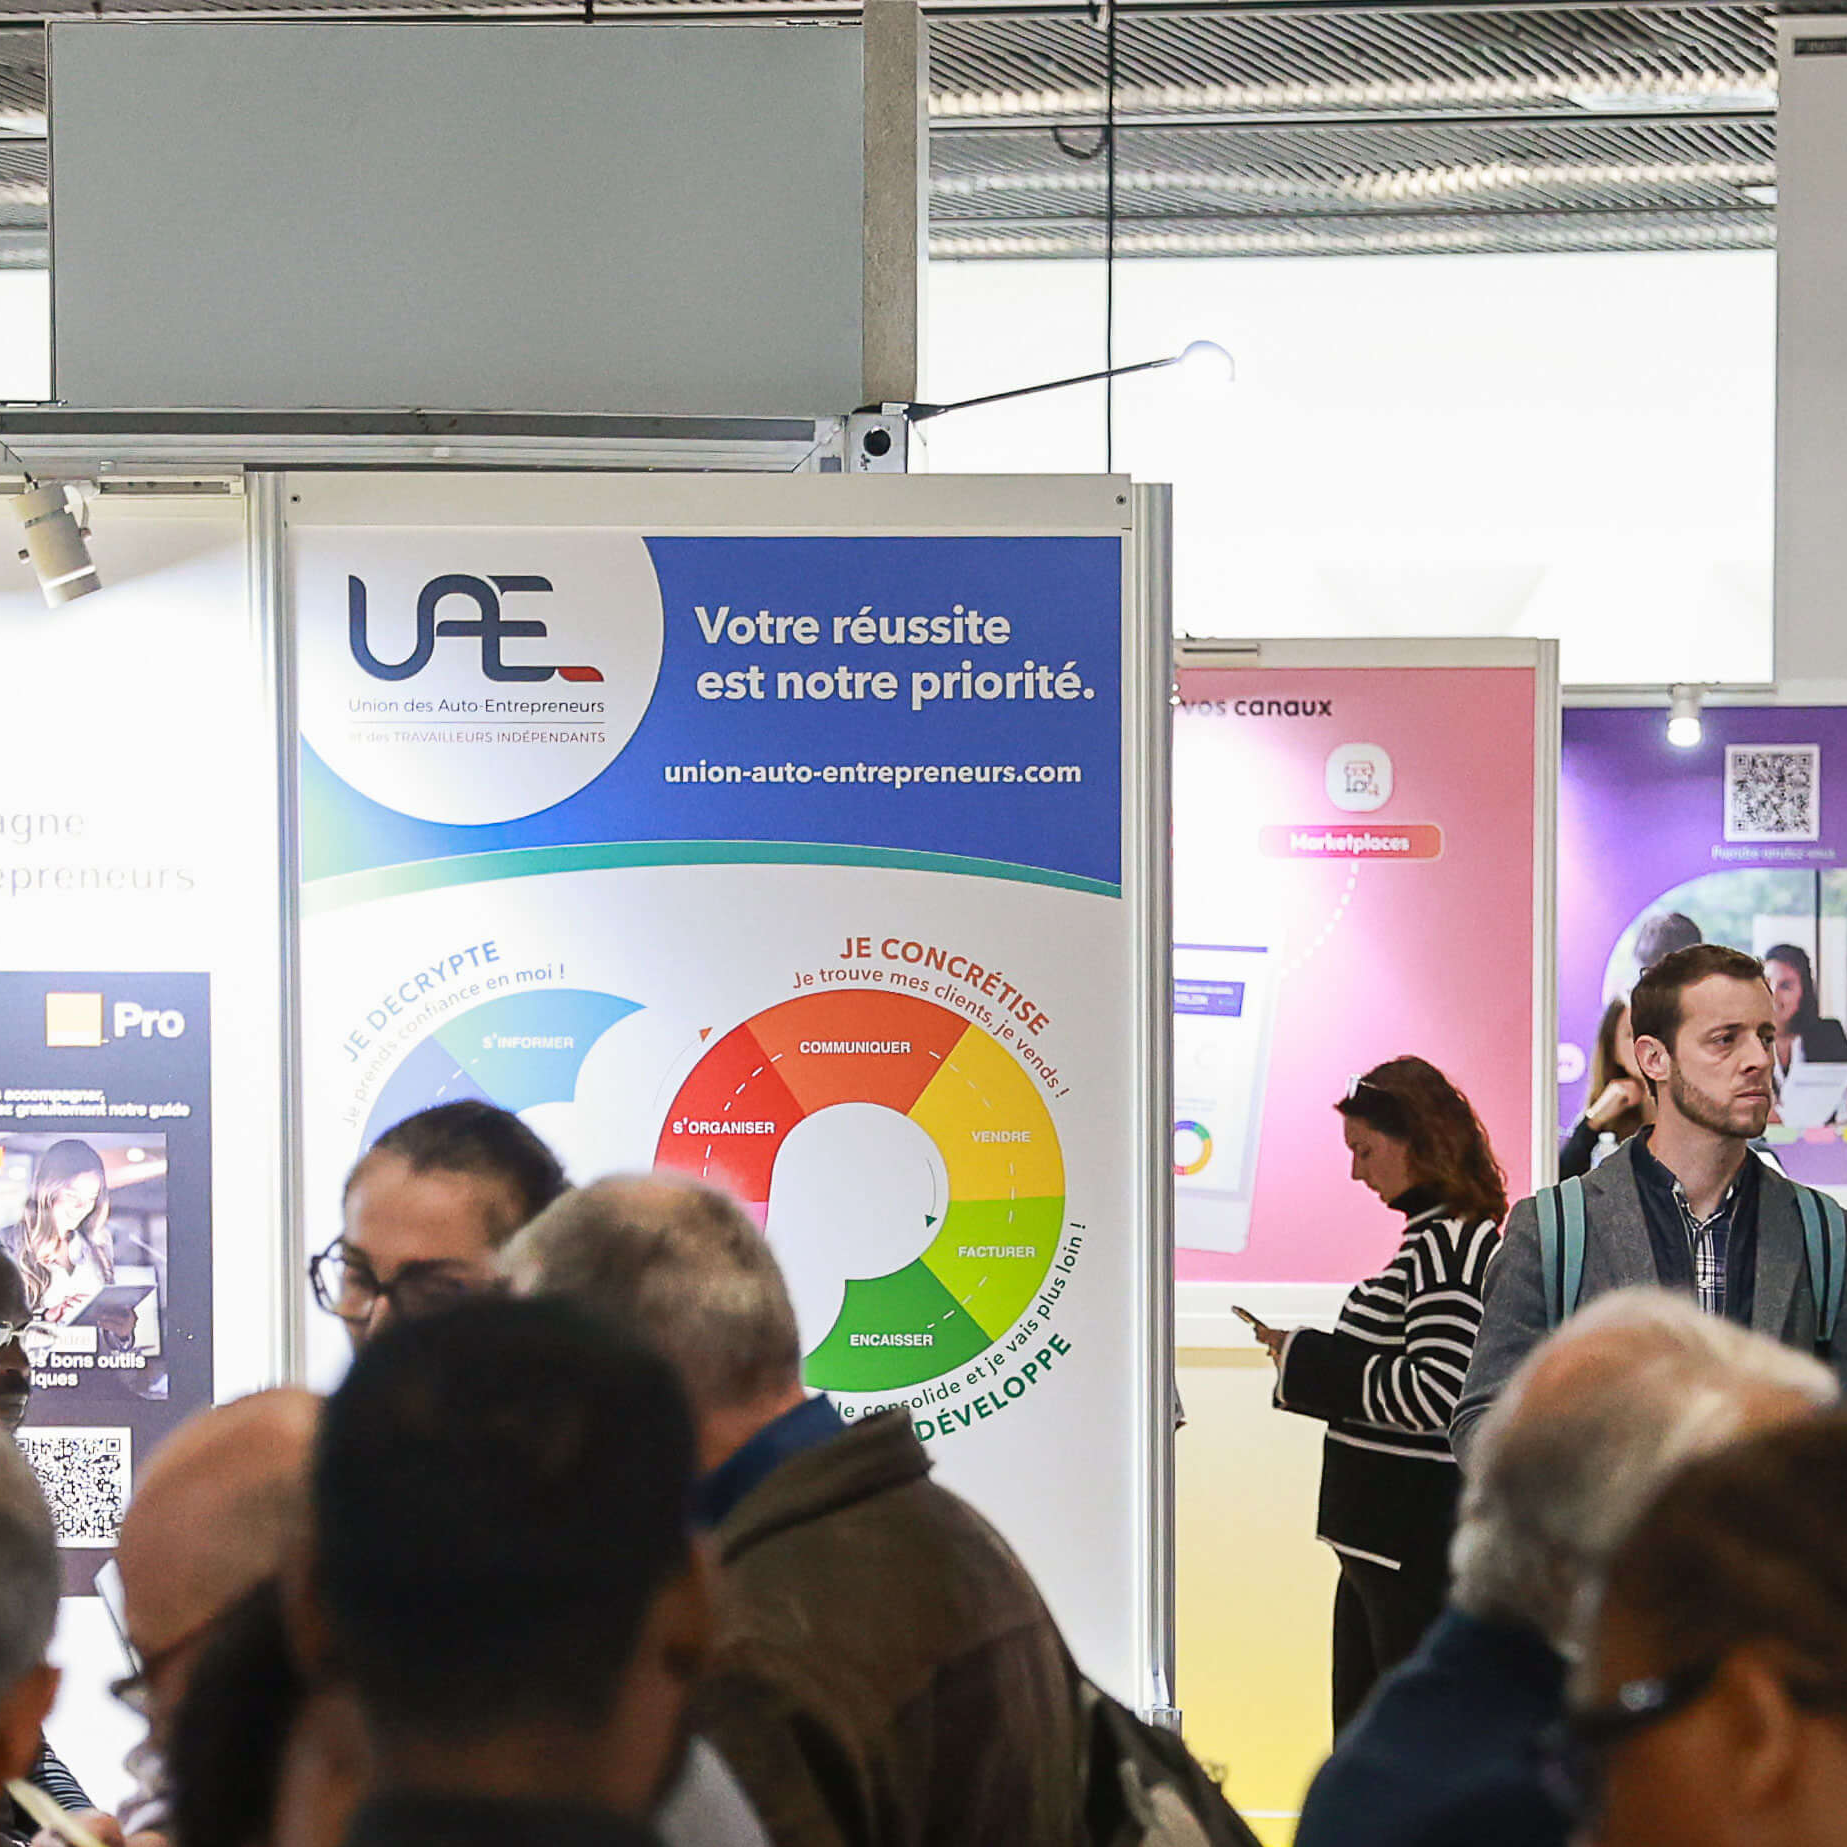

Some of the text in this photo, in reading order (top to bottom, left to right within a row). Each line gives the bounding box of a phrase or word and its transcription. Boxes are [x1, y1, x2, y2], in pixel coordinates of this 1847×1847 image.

[348, 574, 604, 682] UAE
[694, 604, 1011, 645] Votre réussite
[696, 660, 1095, 711] est notre priorité.
[348, 698, 605, 716] Union des Auto-Entrepreneurs
[1234, 698, 1333, 717] canaux
[394, 732, 493, 744] TRAVAILLEURS
[496, 729, 606, 744] INDÉPENDANTS
[664, 759, 1082, 789] union-auto-entrepreneurs.com
[1289, 832, 1410, 855] Marketplaces
[840, 937, 1050, 1036] JE CONCRÉTISE
[400, 982, 481, 1040] confiance
[485, 975, 510, 991] en
[515, 964, 553, 983] moi
[113, 1002, 186, 1040] Pro
[793, 971, 815, 990] Je
[819, 966, 884, 983] trouve
[890, 972, 930, 992] mes
[935, 982, 994, 1028] clients,
[993, 1019, 1014, 1041] je
[1017, 1038, 1060, 1090] vends
[341, 1029, 371, 1062] JE
[482, 1032, 575, 1050] S'INFORMER
[799, 1041, 911, 1055] COMMUNIQUER
[15, 1102, 107, 1119] gratuitement
[108, 1103, 147, 1117] notre
[149, 1102, 191, 1120] guide
[672, 1117, 775, 1134] S'ORGANISER
[971, 1131, 1031, 1143] VENDRE
[958, 1246, 1036, 1258] FACTURER
[966, 1365, 986, 1385] et
[985, 1351, 1006, 1376] je
[1006, 1319, 1039, 1353] vais
[1036, 1277, 1066, 1320] plus
[1055, 1235, 1083, 1274] loin
[849, 1334, 934, 1347] ENCAISSER
[50, 1352, 94, 1369] bons
[98, 1352, 146, 1369] outils
[914, 1333, 1072, 1442] DÉVELOPPE
